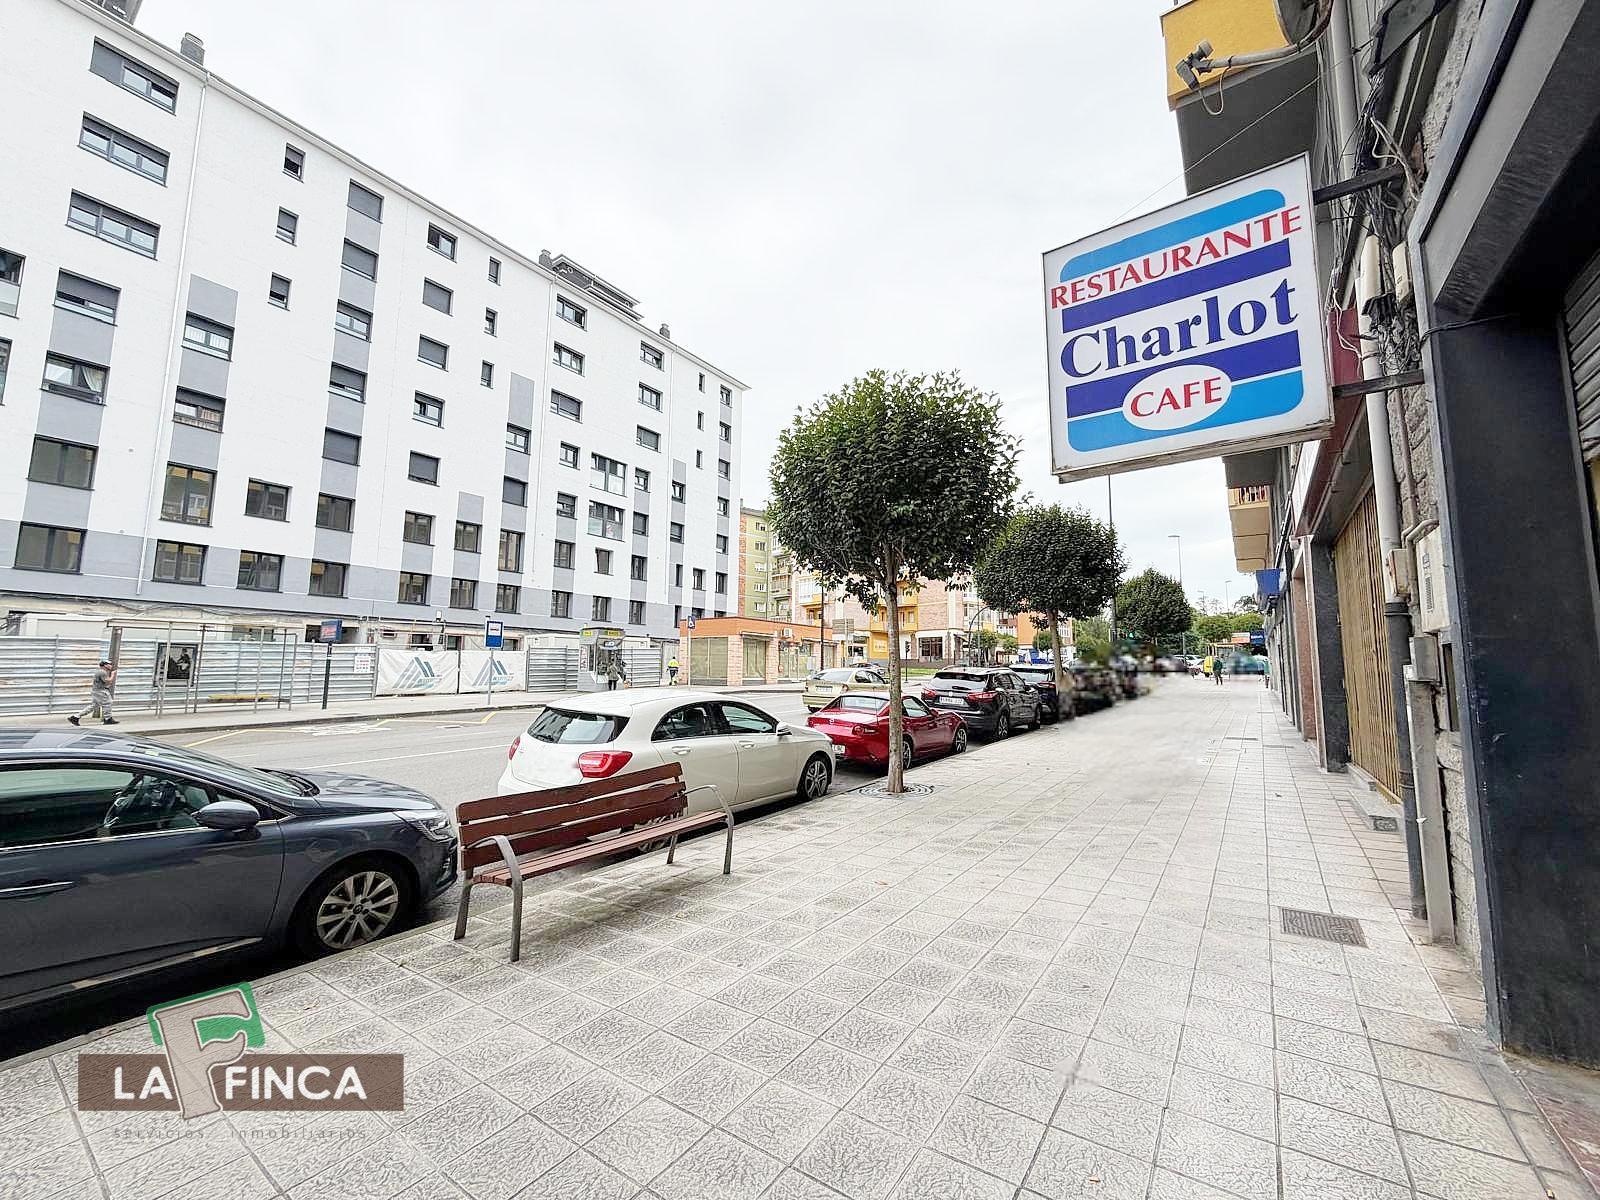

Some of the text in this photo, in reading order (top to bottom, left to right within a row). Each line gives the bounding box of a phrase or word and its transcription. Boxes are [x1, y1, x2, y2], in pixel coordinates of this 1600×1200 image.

[1050, 205, 1302, 309] RESTAURANTE
[1060, 277, 1298, 378] Charlot
[1130, 376, 1222, 417] CAFE
